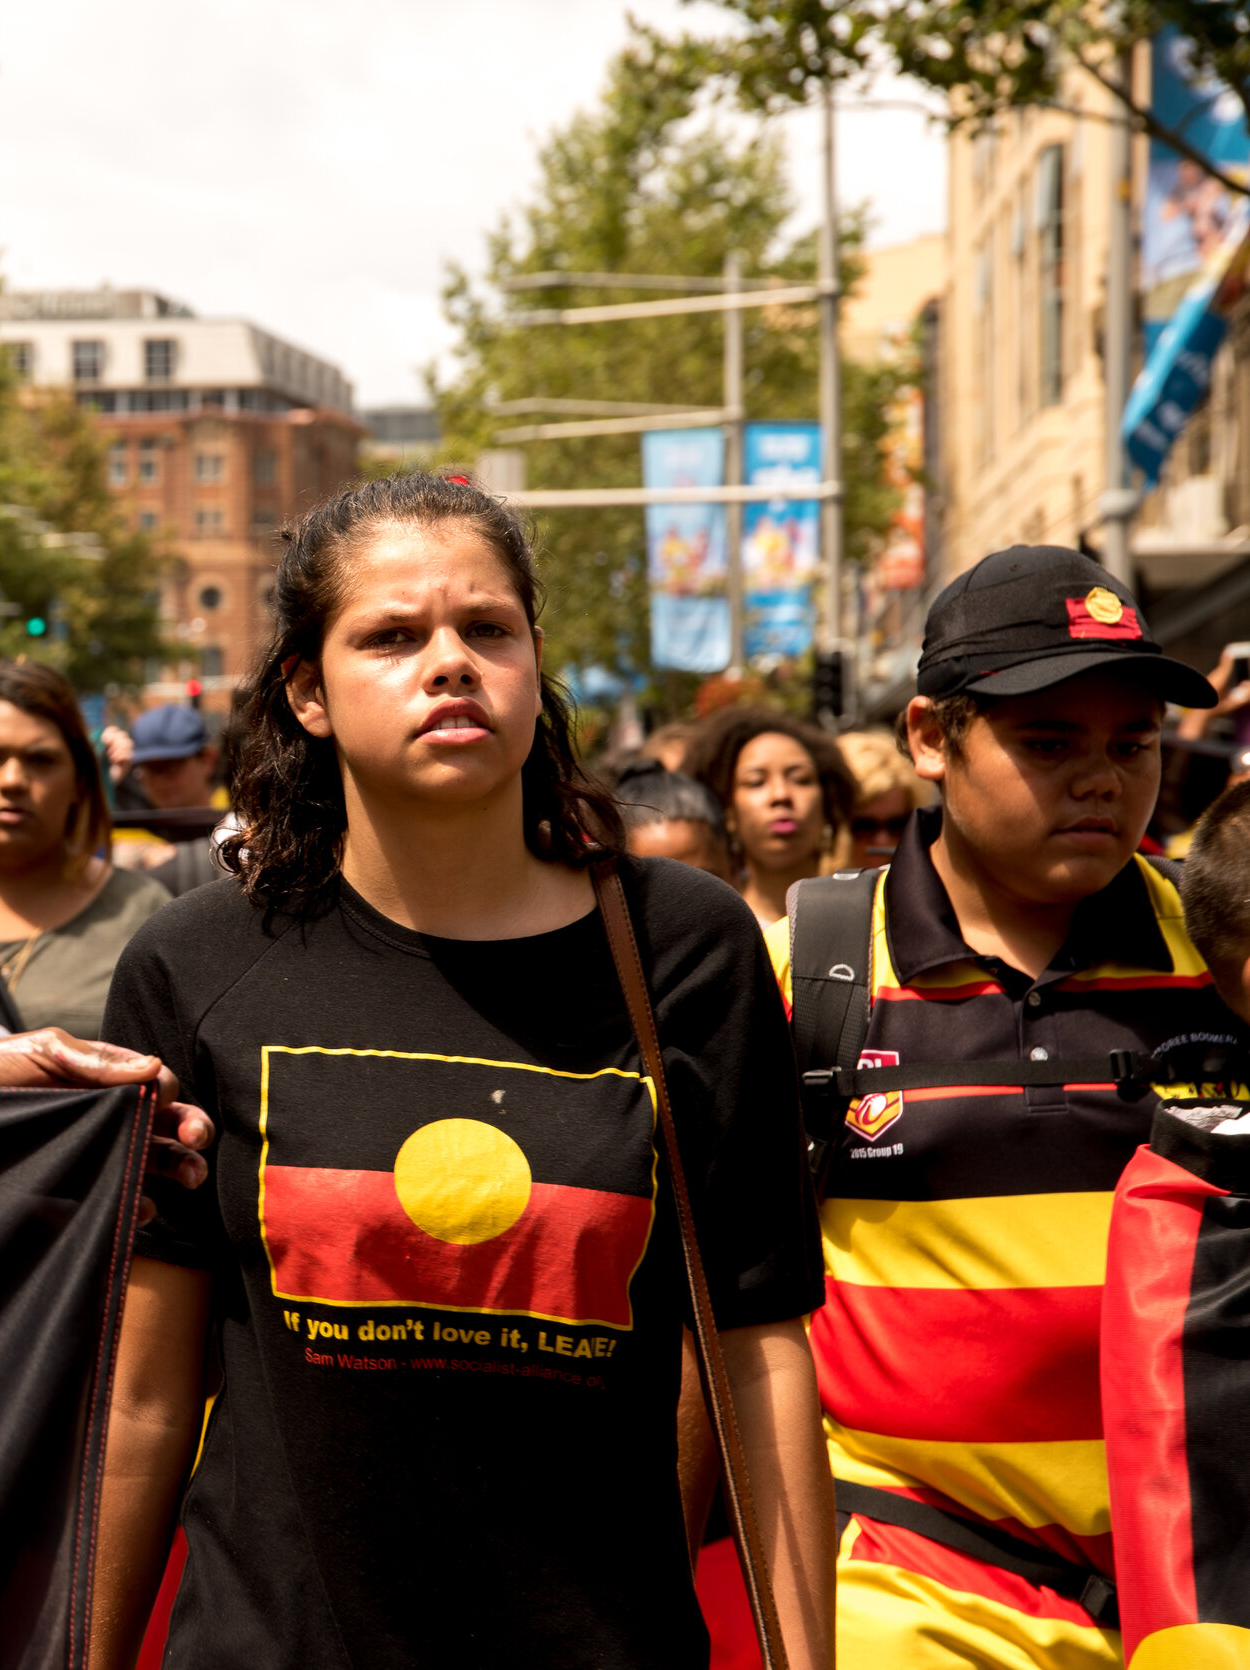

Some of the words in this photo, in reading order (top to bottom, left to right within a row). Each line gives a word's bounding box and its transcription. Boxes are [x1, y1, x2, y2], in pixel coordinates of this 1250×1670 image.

[867, 1145, 892, 1158] Group
[892, 1143, 904, 1155] 19
[283, 1310, 300, 1332] If
[306, 1318, 349, 1341] you
[357, 1319, 425, 1341] don't
[433, 1322, 492, 1346] love
[501, 1328, 529, 1353] it,
[538, 1331, 617, 1359] LEAE!
[304, 1347, 334, 1367] Sam
[337, 1353, 397, 1370] Watson
